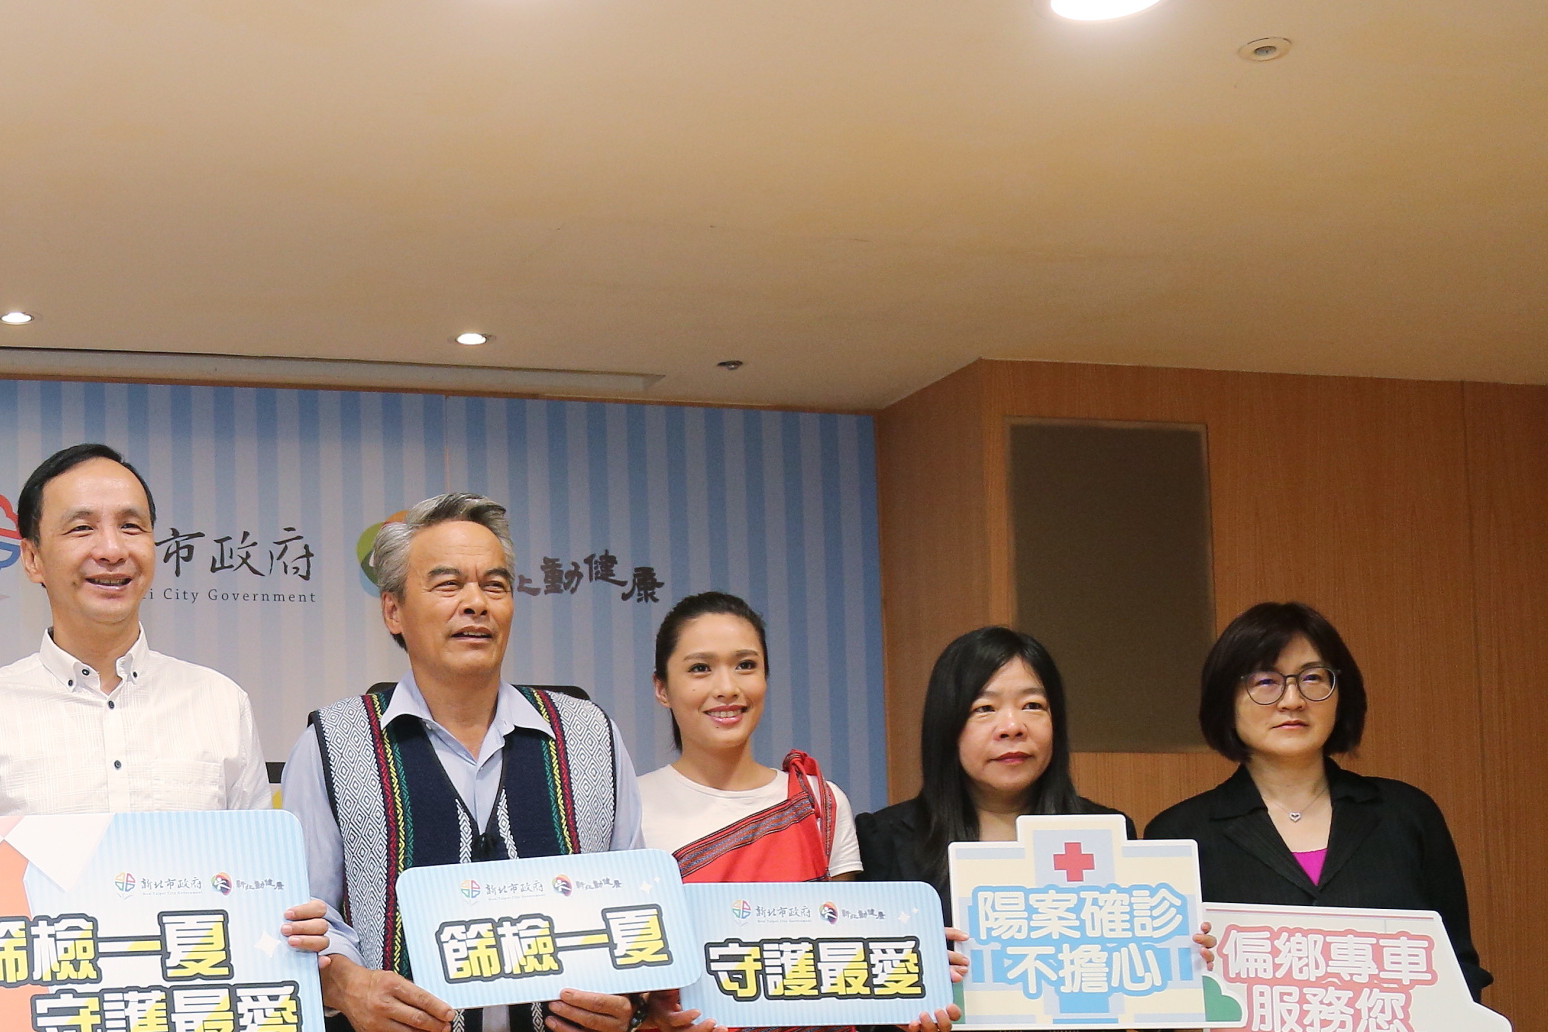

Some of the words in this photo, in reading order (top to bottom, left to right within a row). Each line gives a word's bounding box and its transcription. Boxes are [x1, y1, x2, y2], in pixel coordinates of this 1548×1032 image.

[154, 526, 315, 581] 市政府
[163, 587, 199, 604] City
[207, 588, 316, 603] Government
[140, 876, 203, 891] 新北市政府
[977, 889, 1184, 942] 陽案確診
[440, 907, 669, 980] 篩檢一夏
[710, 940, 923, 998] 守護最愛
[1006, 944, 1163, 994] 不擔心
[1223, 930, 1433, 987] 偏鄉專車
